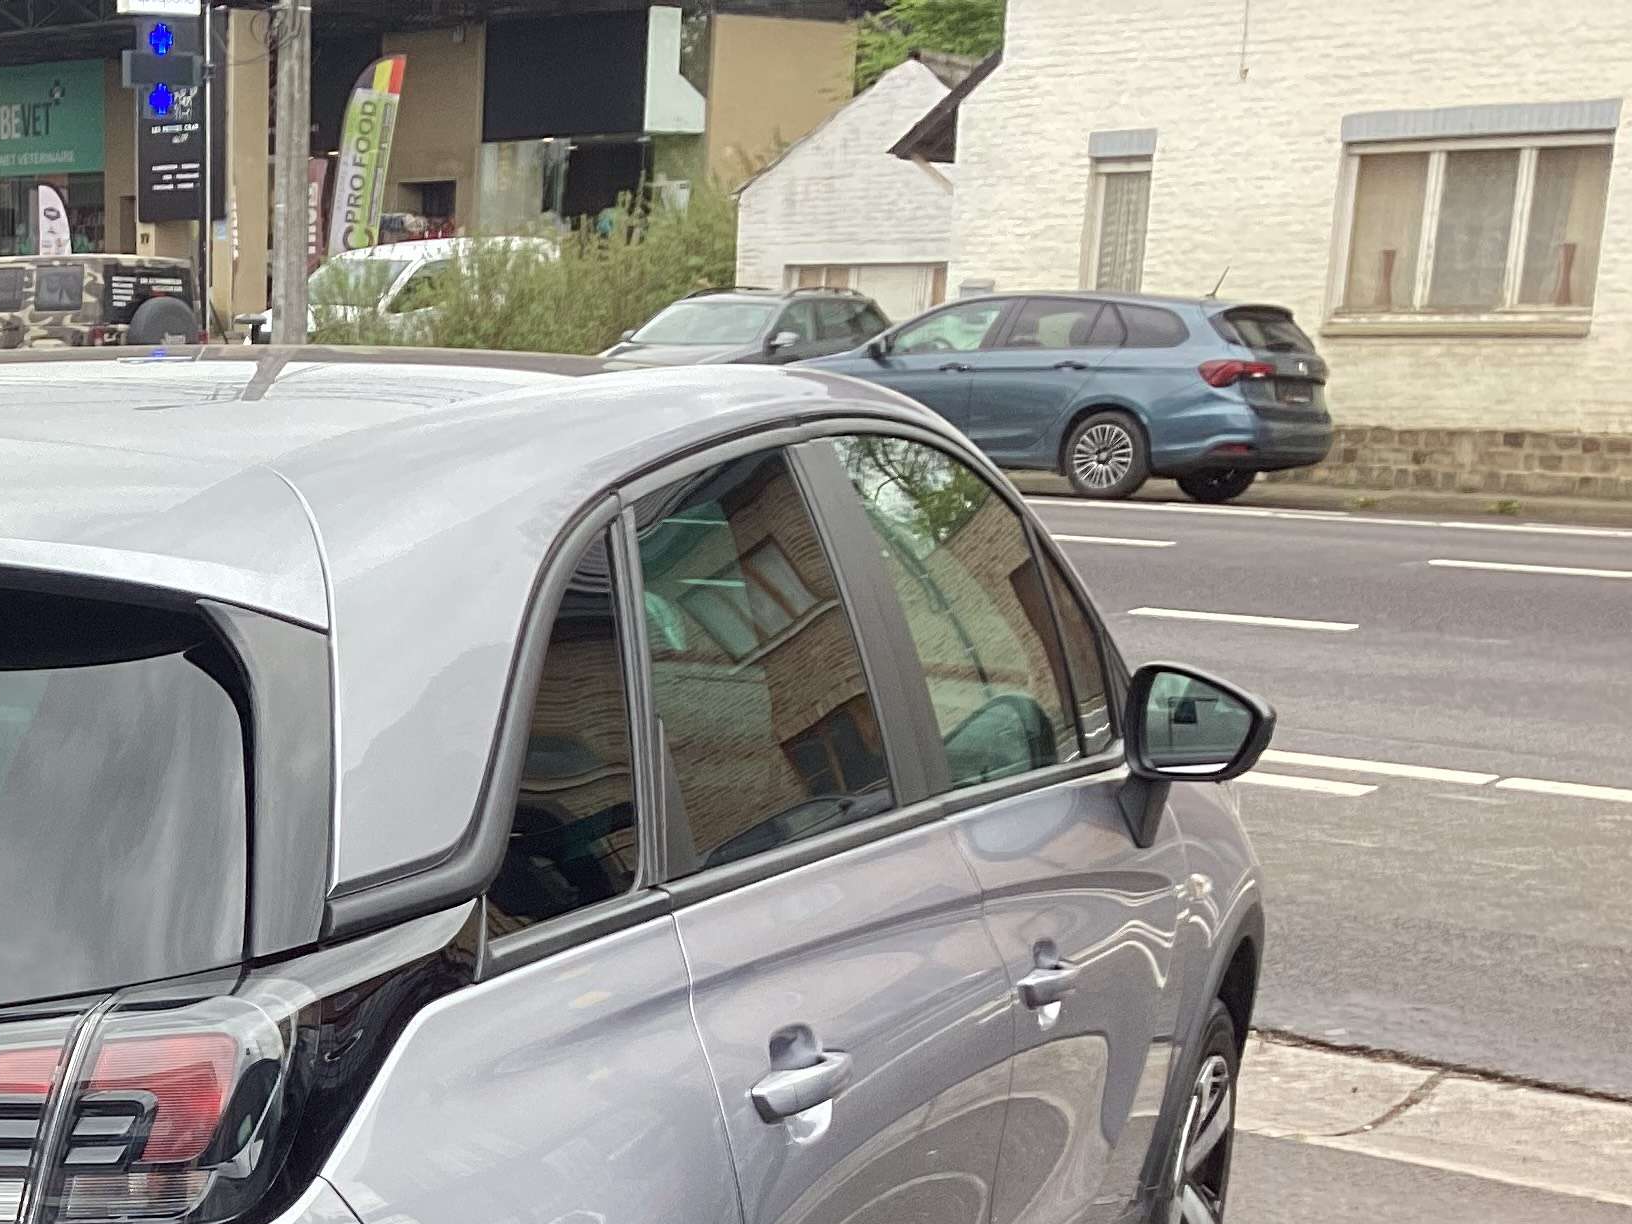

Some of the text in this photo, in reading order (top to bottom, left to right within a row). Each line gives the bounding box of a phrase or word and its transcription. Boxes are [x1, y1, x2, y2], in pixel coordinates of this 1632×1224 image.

[0, 102, 52, 140] BEVET
[345, 101, 377, 224] PRO FOOD
